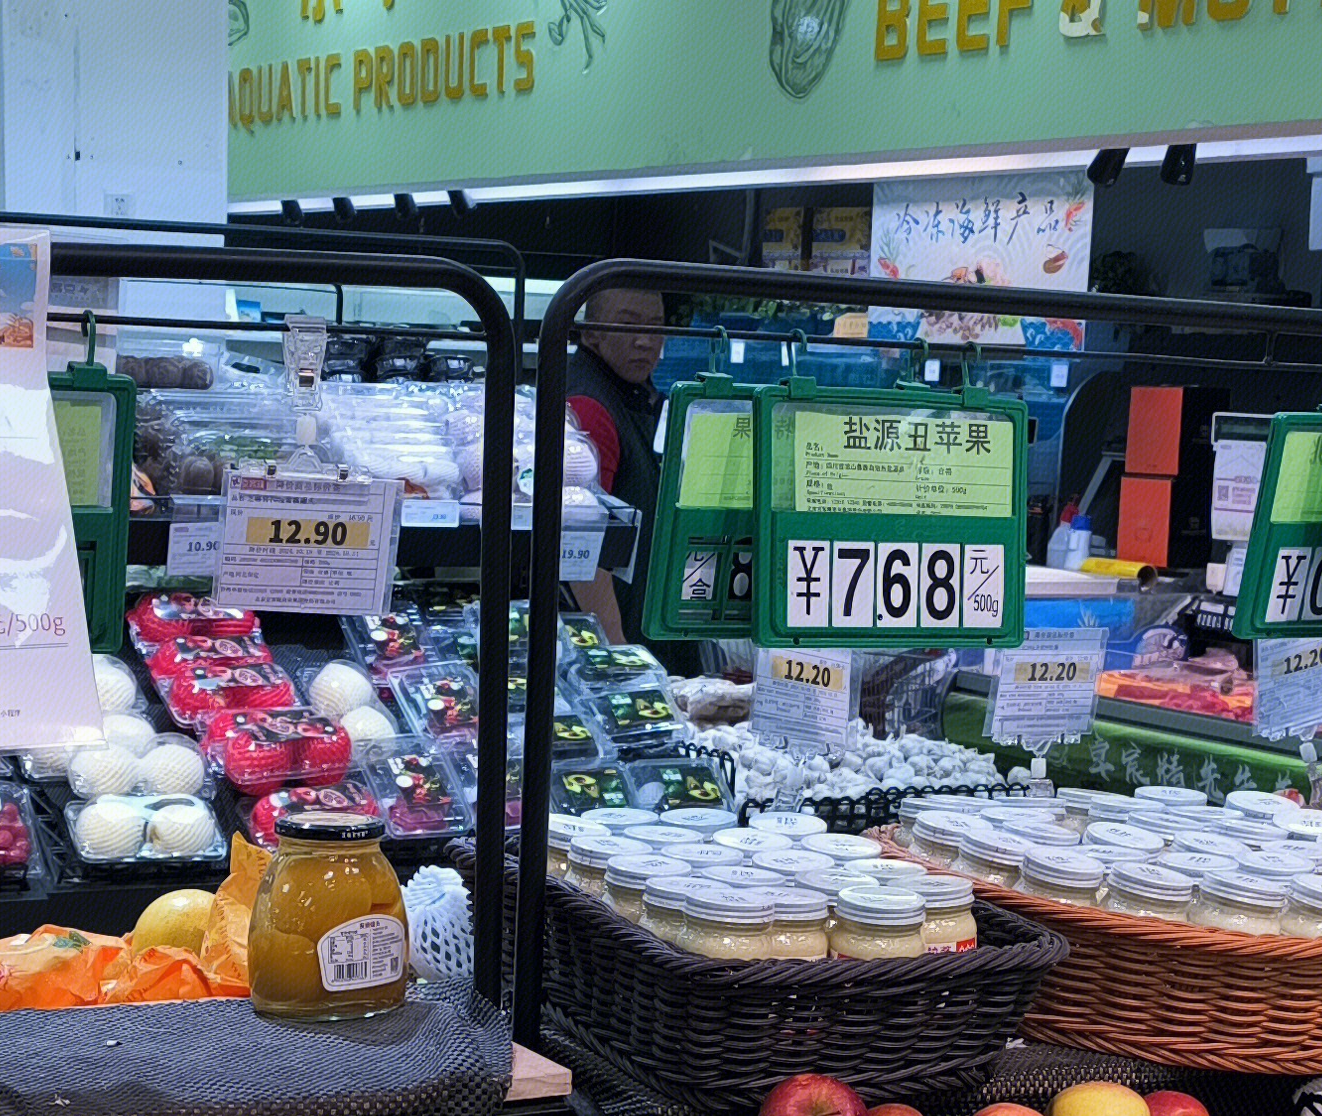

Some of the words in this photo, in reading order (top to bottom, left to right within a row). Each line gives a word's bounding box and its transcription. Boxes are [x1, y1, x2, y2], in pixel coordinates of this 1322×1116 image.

[353, 21, 536, 114] PRODUCTS
[894, 192, 1059, 246] 冷冻海鲜产品
[843, 416, 991, 455] 盐源丑苹果
[268, 519, 348, 546] 12.90
[562, 549, 590, 560] 19.90
[793, 546, 956, 620] ¥7.68
[784, 660, 831, 687] 12.20
[1028, 661, 1077, 681] 12.20
